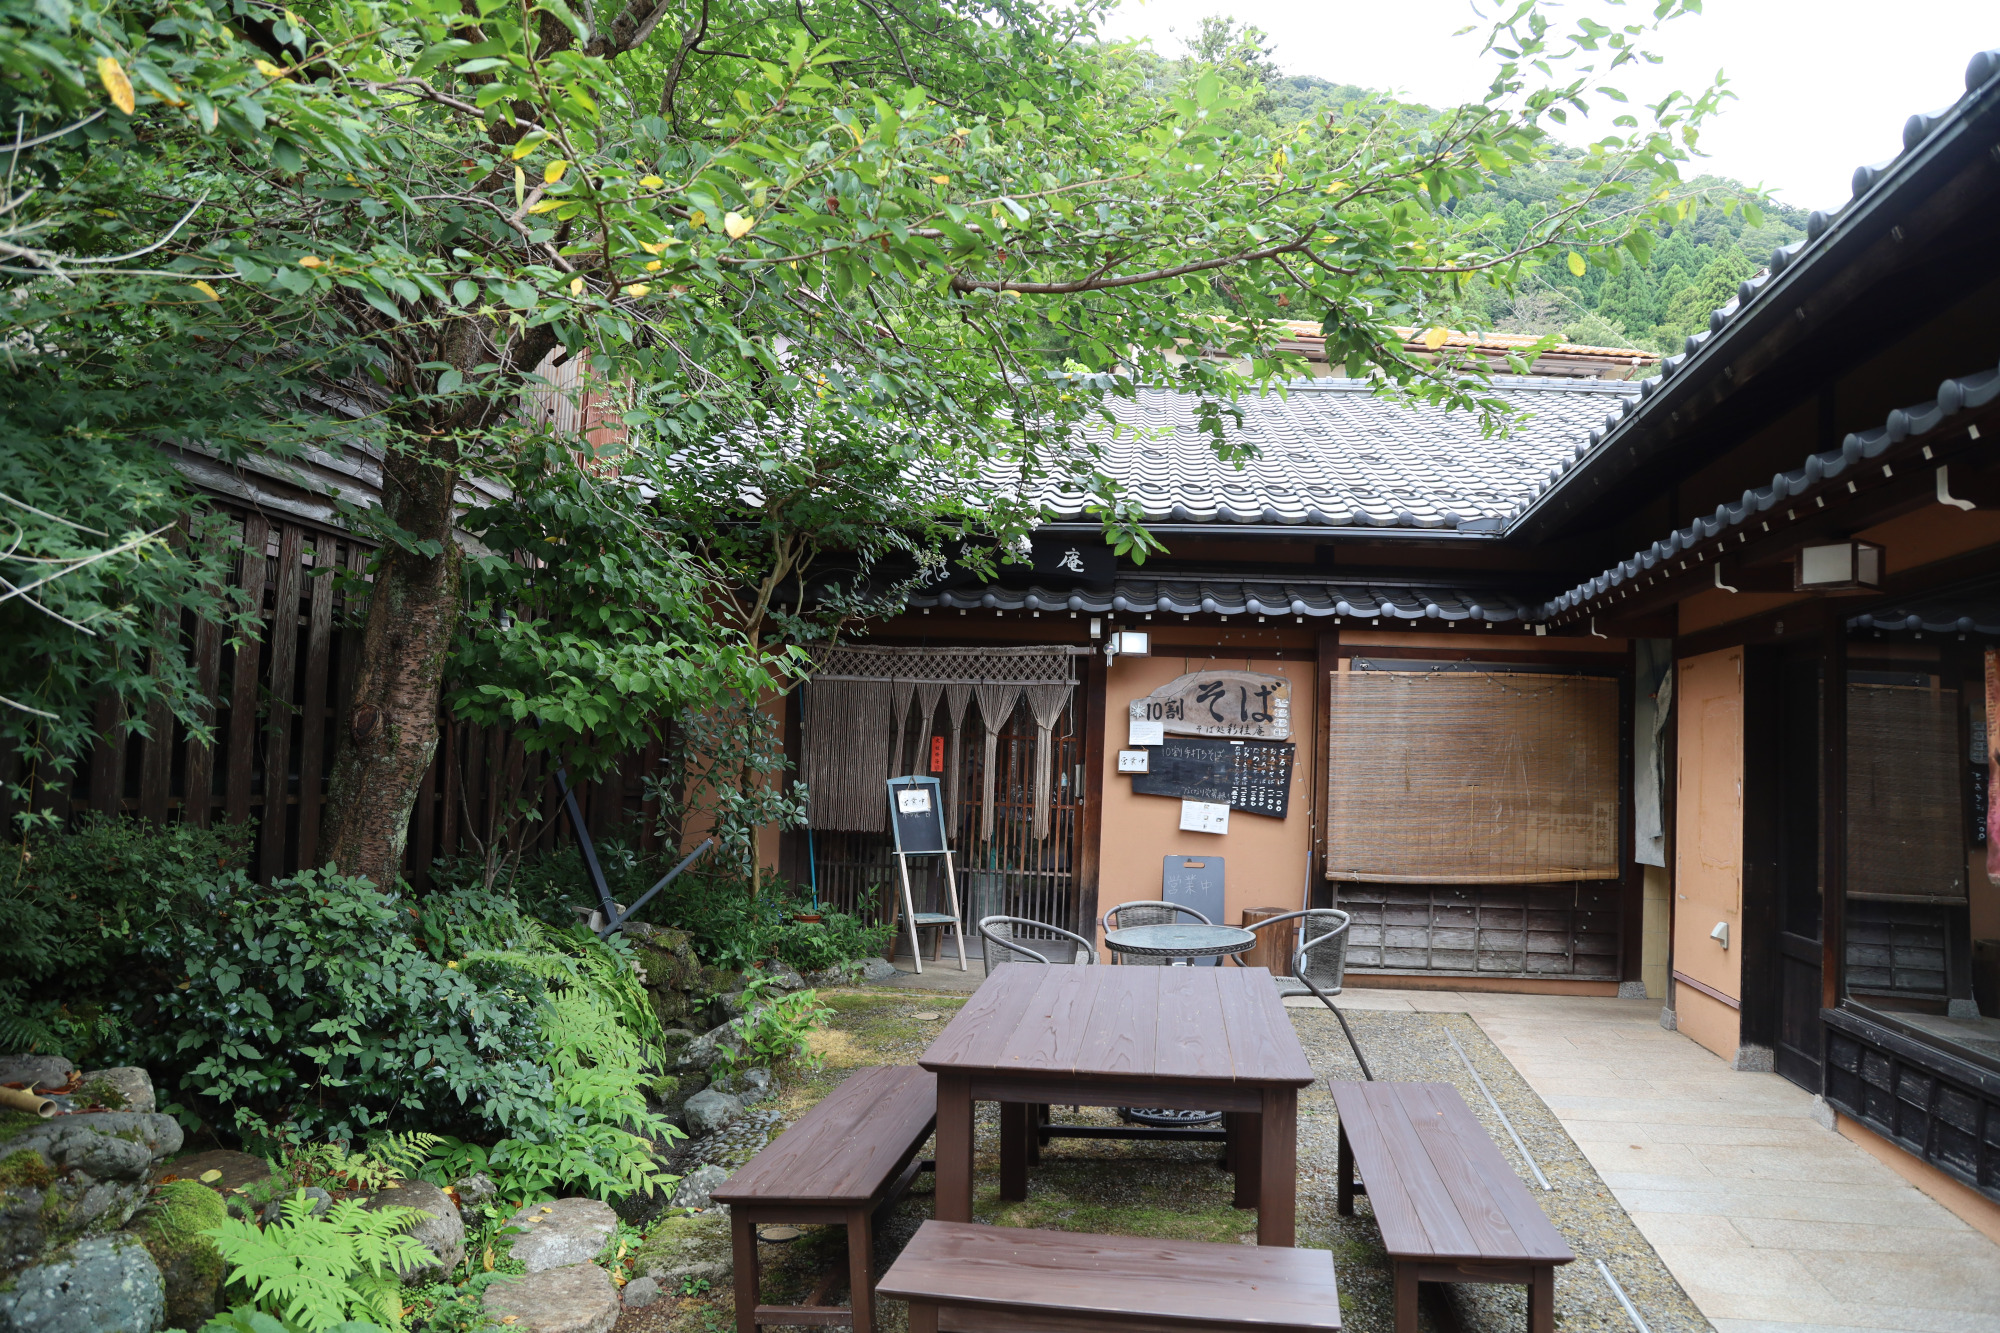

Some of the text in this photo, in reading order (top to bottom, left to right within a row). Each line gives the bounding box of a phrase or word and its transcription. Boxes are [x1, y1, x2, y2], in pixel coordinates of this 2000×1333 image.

[1147, 698, 1184, 721] 10割
[1197, 681, 1281, 722] そば
[1168, 874, 1212, 896] 営業中
